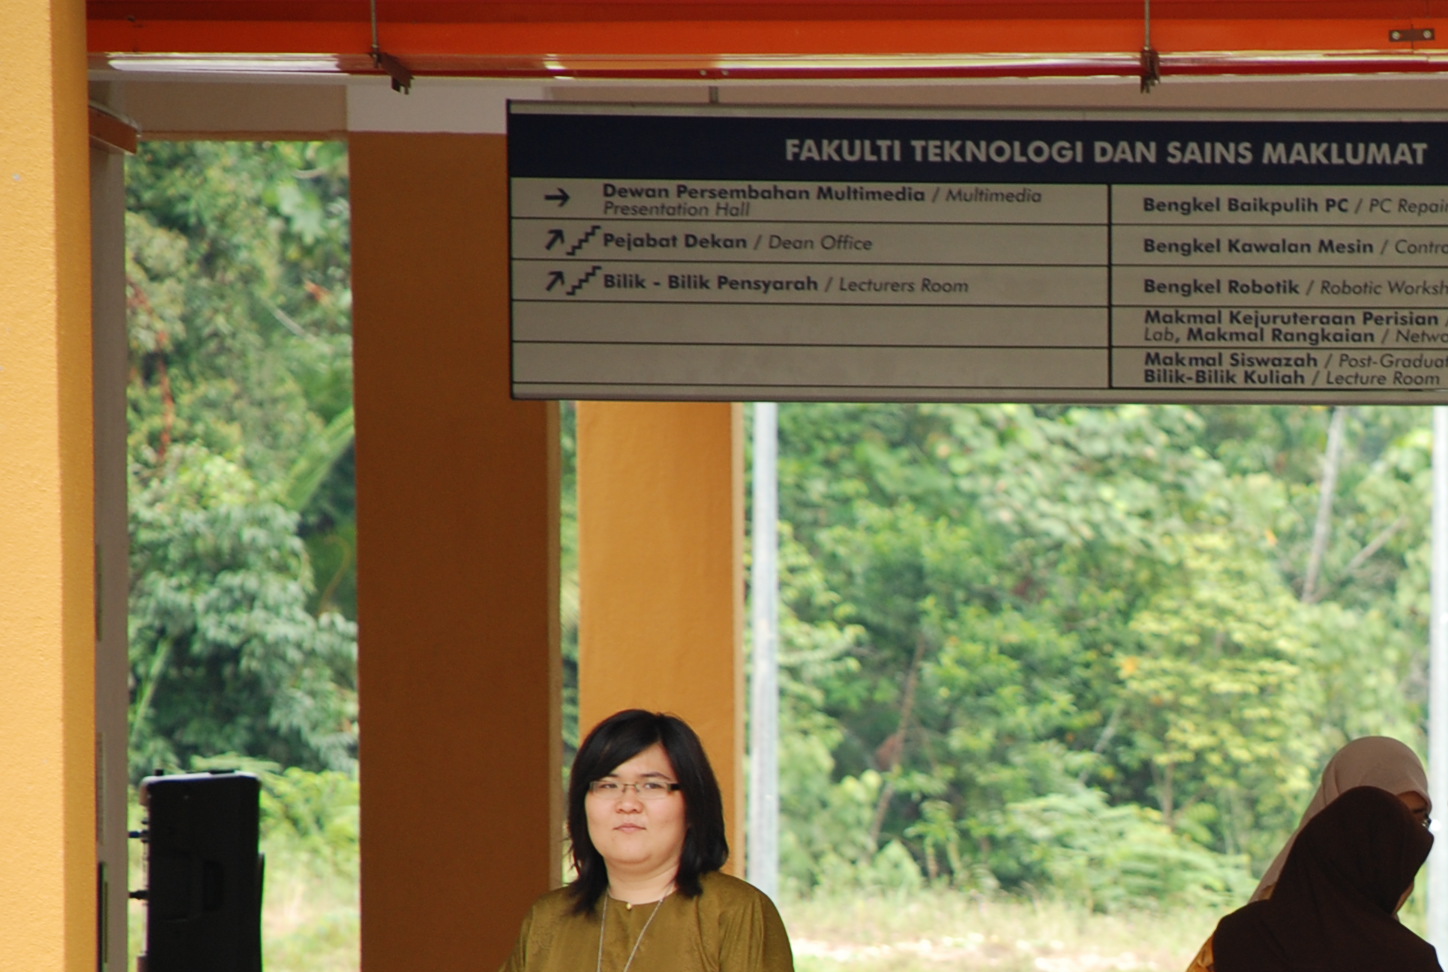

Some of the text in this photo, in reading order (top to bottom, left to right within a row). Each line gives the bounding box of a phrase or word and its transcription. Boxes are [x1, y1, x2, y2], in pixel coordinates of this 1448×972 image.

[785, 138, 1428, 165] FAKULTI TEKNOLOGI DAN SAINS MAKLUMAT
[602, 183, 1042, 204] Dewan Persembahan Multimedia / Multimedia
[603, 200, 751, 217] Presentation Hall
[1143, 196, 1221, 216] Bengkel
[1227, 197, 1319, 216] Baikpulih
[1325, 198, 1349, 213] PC
[1353, 197, 1364, 215] /
[1368, 197, 1393, 214] PC
[603, 232, 873, 251] Pejabat Dekan / Dean Office
[1143, 237, 1221, 257] Bengkel
[1227, 238, 1312, 254] Kawalan
[1317, 239, 1374, 254] Mesin
[1379, 239, 1390, 256] /
[603, 273, 646, 289] Bilik
[668, 274, 711, 290] Bilik
[717, 274, 818, 294] Pensyarah
[824, 276, 834, 293] /
[839, 276, 915, 293] Lecturers
[920, 277, 969, 293] Room
[1143, 278, 1221, 298] Bengkel
[1228, 279, 1300, 295] Robotik
[1305, 279, 1315, 297] /
[1320, 279, 1382, 296] Robotic
[1144, 309, 1222, 325] Makmal
[1229, 310, 1357, 330] Kejuruteraan
[1362, 311, 1439, 326] Perisian
[1143, 327, 1181, 346] Lab,
[1186, 327, 1265, 343] Makmal
[1271, 327, 1375, 347] Rangkaian
[1380, 327, 1390, 345] /
[1144, 352, 1223, 368] Makmal
[1229, 352, 1318, 368] Siswazah
[1323, 352, 1334, 370] /
[1143, 368, 1441, 387] Bilik-Bilik Kuliah / Lecture Room
